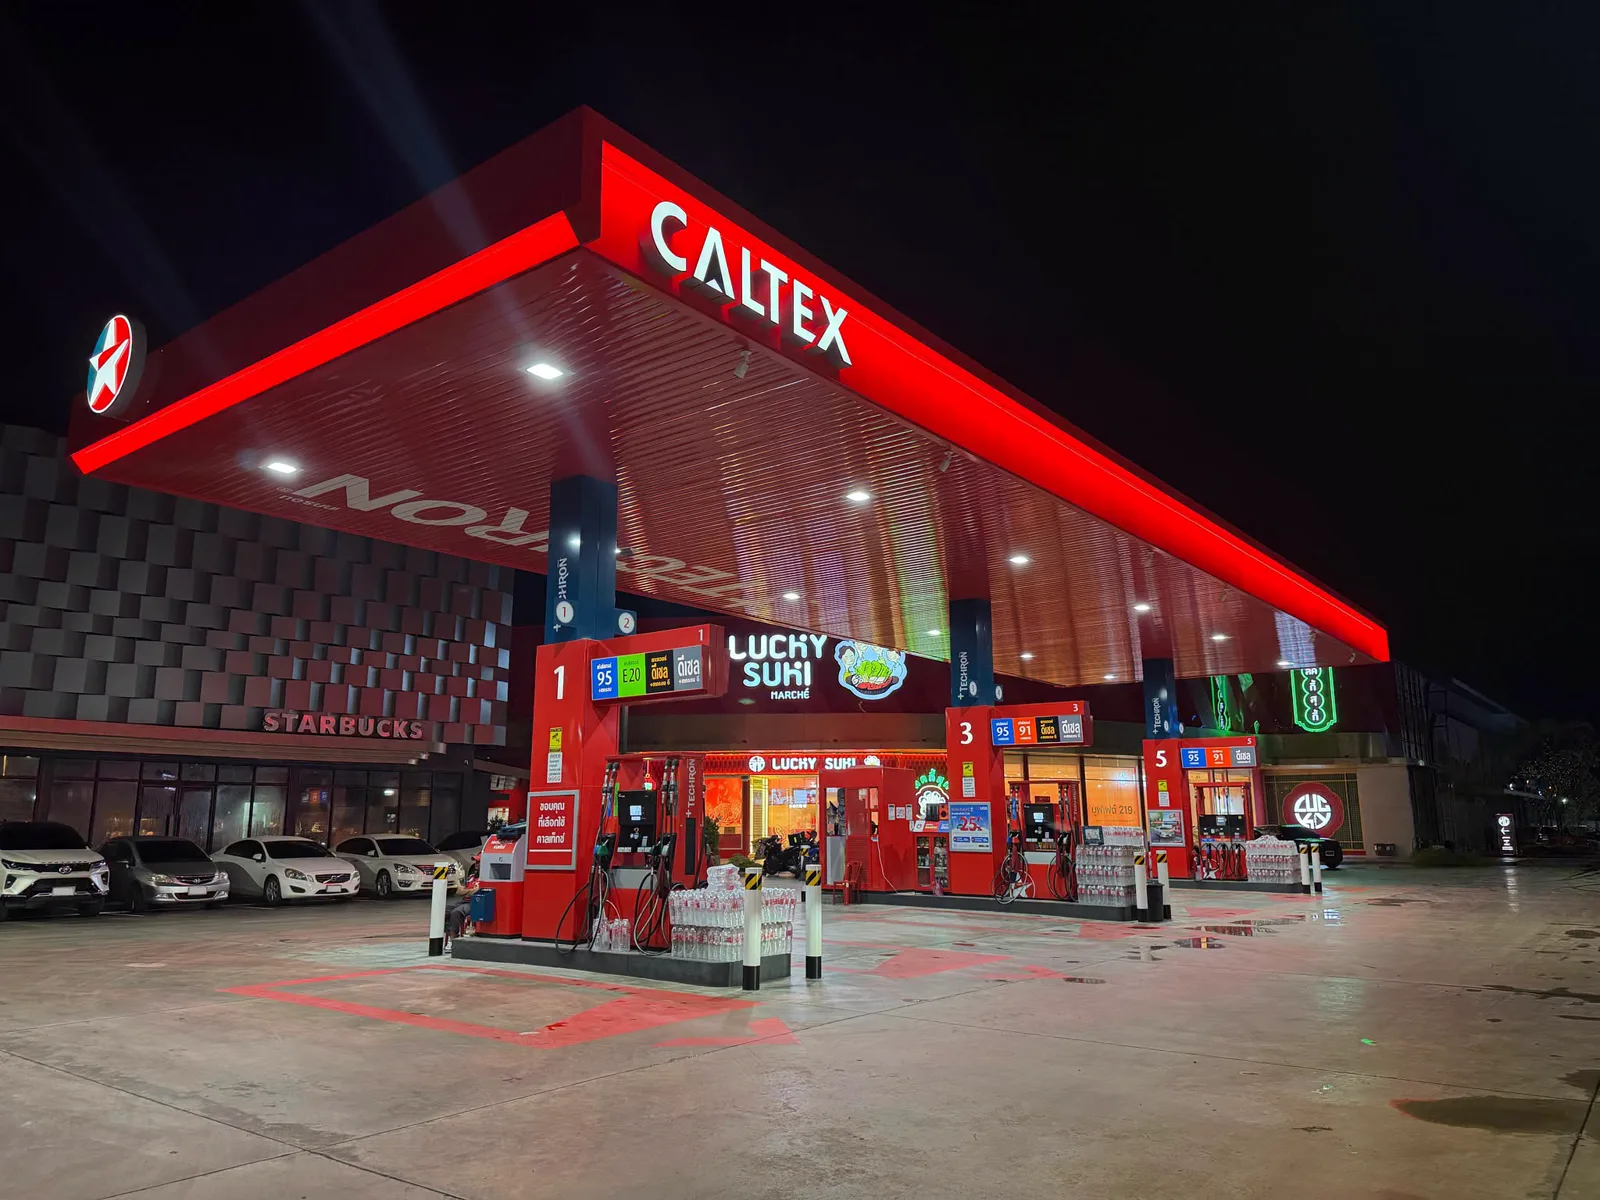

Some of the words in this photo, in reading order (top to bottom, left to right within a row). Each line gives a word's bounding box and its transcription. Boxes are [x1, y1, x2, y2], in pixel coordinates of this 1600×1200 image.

[650, 200, 853, 366] CALTEX
[561, 606, 567, 618] 1
[623, 617, 630, 629] 2
[697, 628, 704, 641] 1
[728, 634, 828, 660] LUCKY
[677, 654, 700, 677] ดีเซล
[597, 670, 612, 686] 95
[742, 661, 812, 687] SUKI
[553, 665, 565, 700] 1
[770, 687, 810, 700] MARCHÉ
[1072, 703, 1079, 712] 3
[263, 711, 424, 740] STARBUCKS
[996, 726, 1010, 737] 95
[1018, 726, 1032, 736] 91
[960, 721, 973, 745] 3
[772, 757, 817, 770] LUCKY
[824, 757, 856, 770] SUKI
[1155, 750, 1167, 767] 5
[1188, 753, 1200, 762] 95
[1213, 753, 1224, 761] 91
[539, 802, 565, 814] ขอบคุณ
[537, 814, 566, 828] ที่เลือกใช้
[536, 831, 566, 844] คาลเท็กซ์
